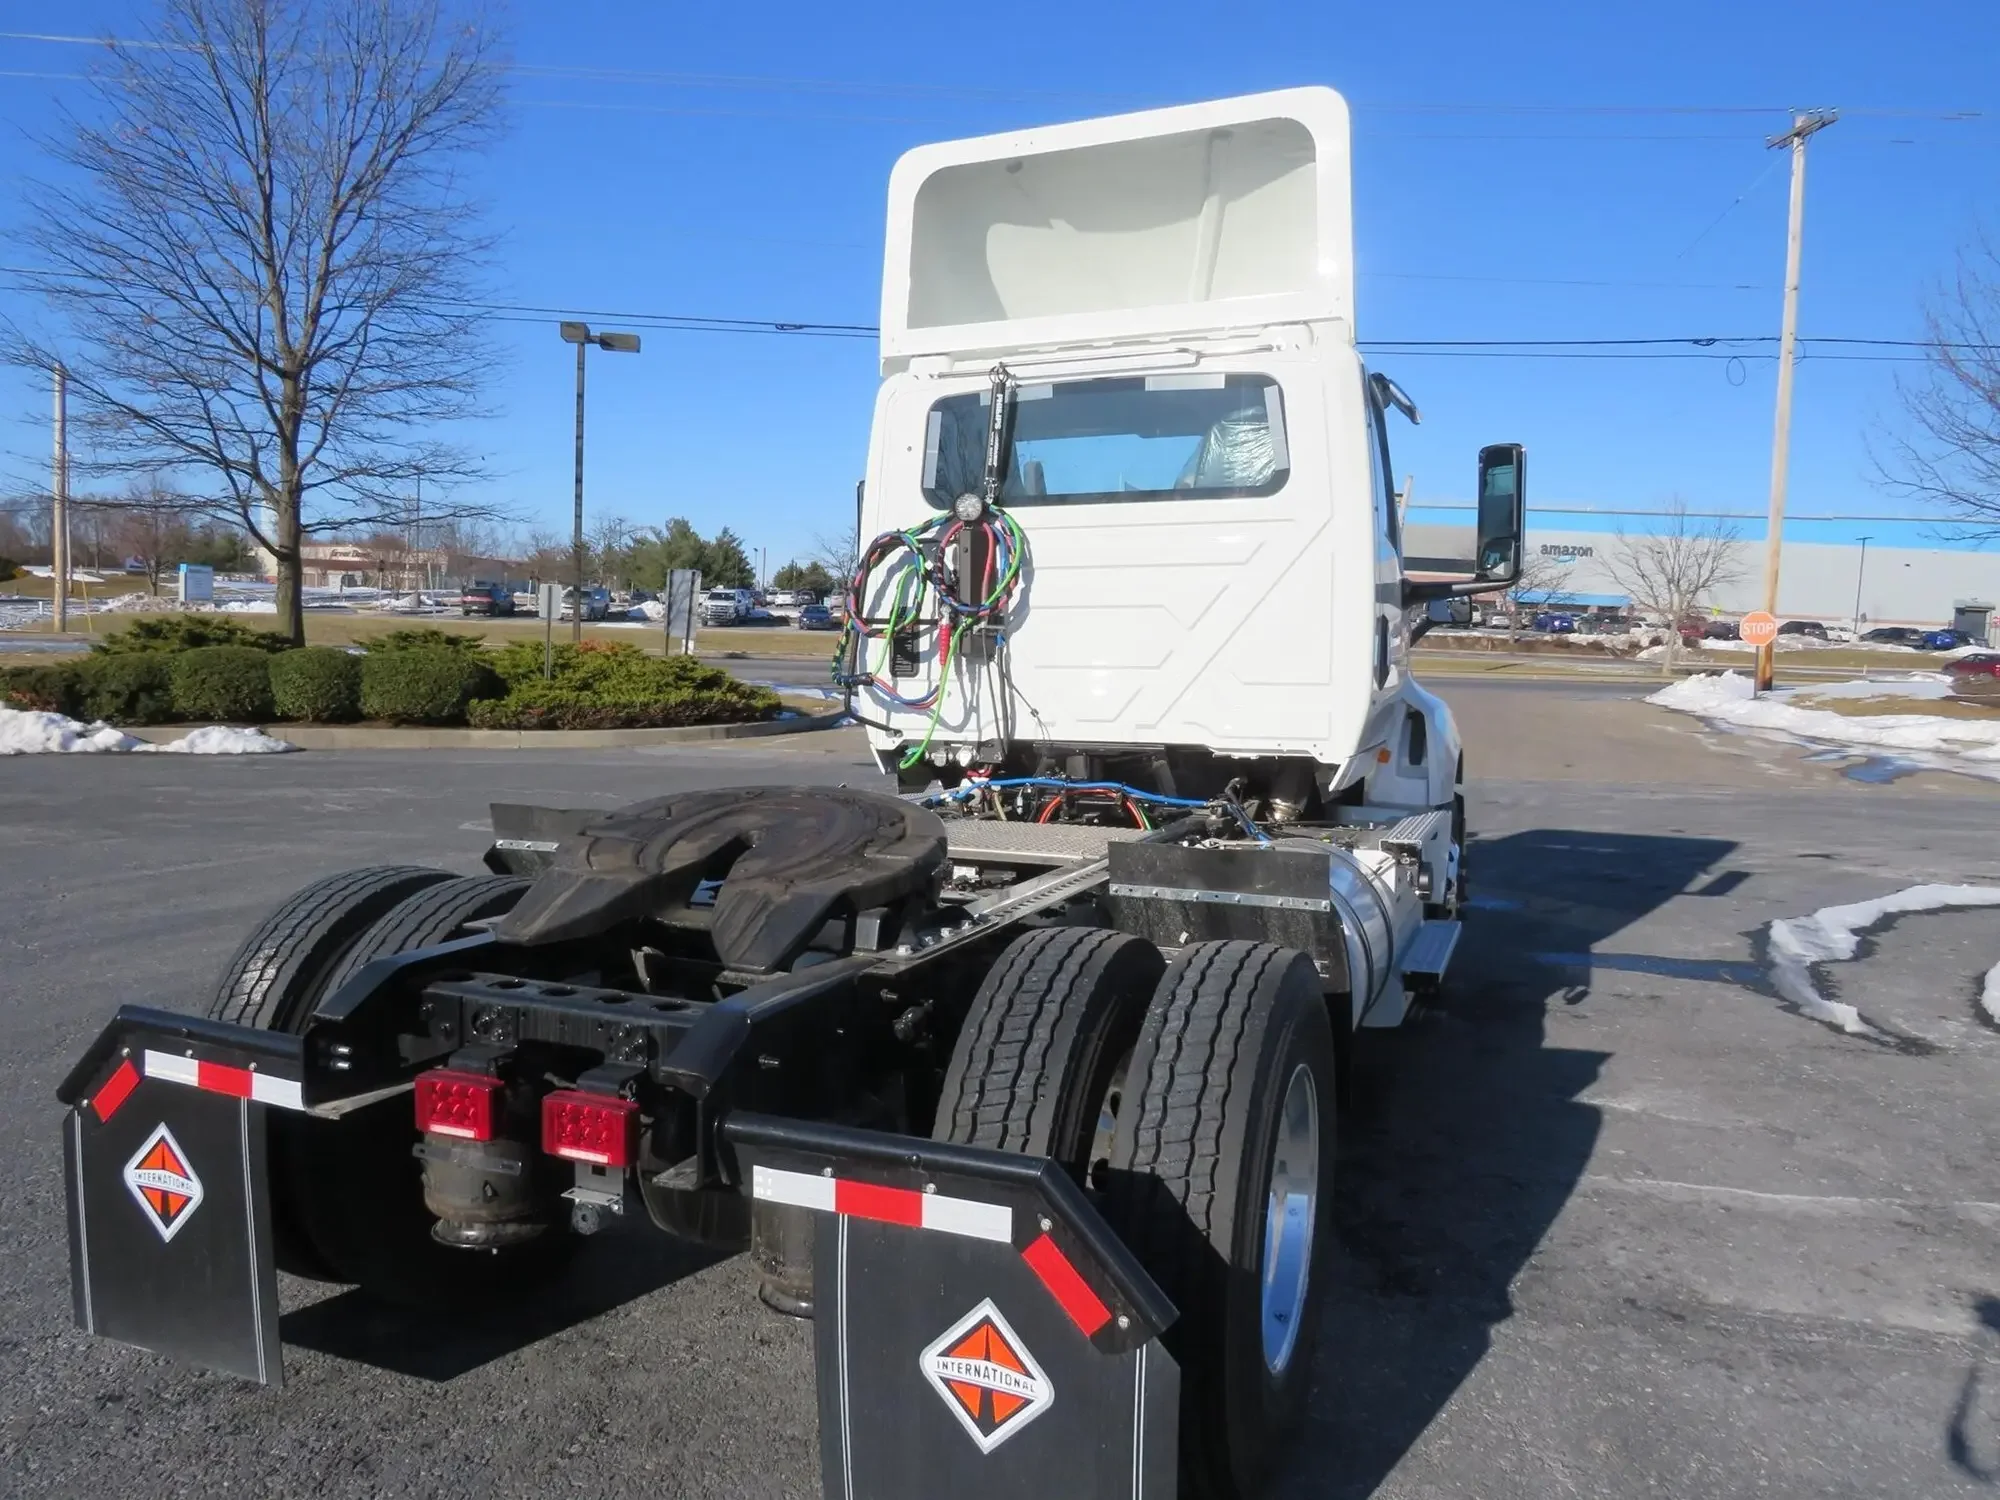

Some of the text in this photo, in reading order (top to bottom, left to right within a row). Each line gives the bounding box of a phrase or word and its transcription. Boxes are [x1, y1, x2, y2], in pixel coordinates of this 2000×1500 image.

[1540, 544, 1593, 557] amazon
[1743, 622, 1774, 635] STOP
[134, 1172, 195, 1192] INTERNATIONAL
[936, 1360, 1036, 1393] INTERNATIONAL
